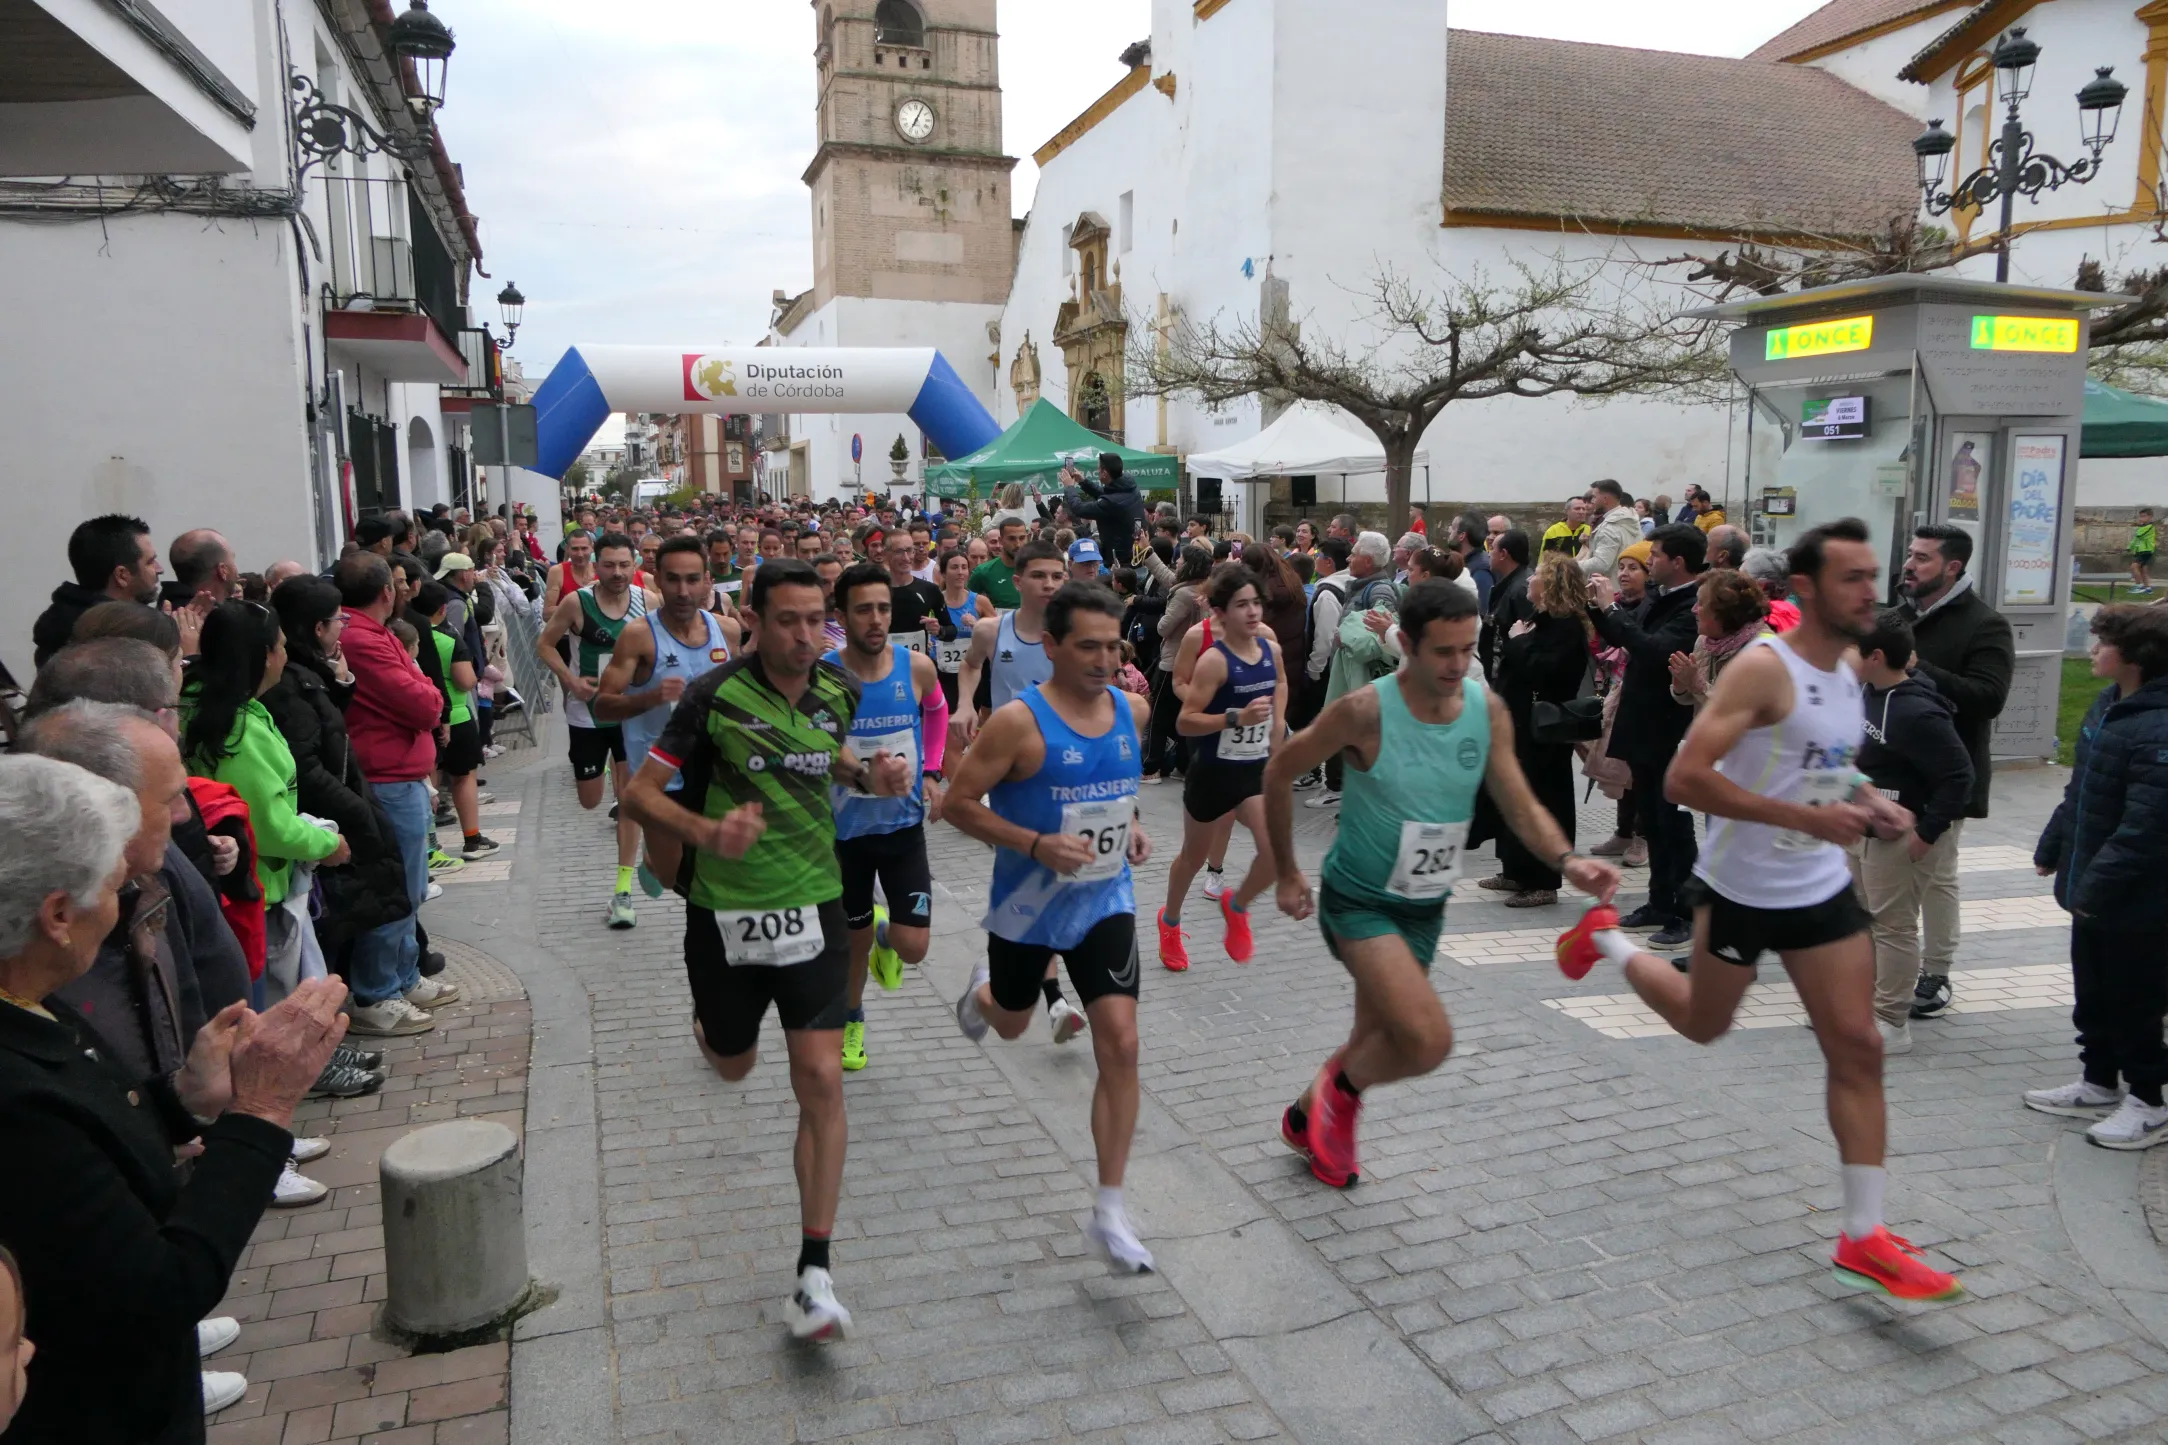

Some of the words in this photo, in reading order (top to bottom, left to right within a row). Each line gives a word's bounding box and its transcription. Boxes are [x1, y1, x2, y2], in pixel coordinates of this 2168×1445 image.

[1797, 324, 1862, 350] ONCE
[2004, 324, 2067, 346] ONCE
[747, 364, 843, 382] Diputación
[747, 383, 767, 397] de
[774, 383, 844, 398] Córdoba
[1823, 425, 1840, 435] 051
[1122, 467, 1172, 477] NDALUZA
[2024, 489, 2045, 501] DEL
[2010, 500, 2055, 523] PADRE
[1231, 725, 1266, 744] 313
[1410, 845, 1457, 876] 282
[736, 906, 805, 942] 208
